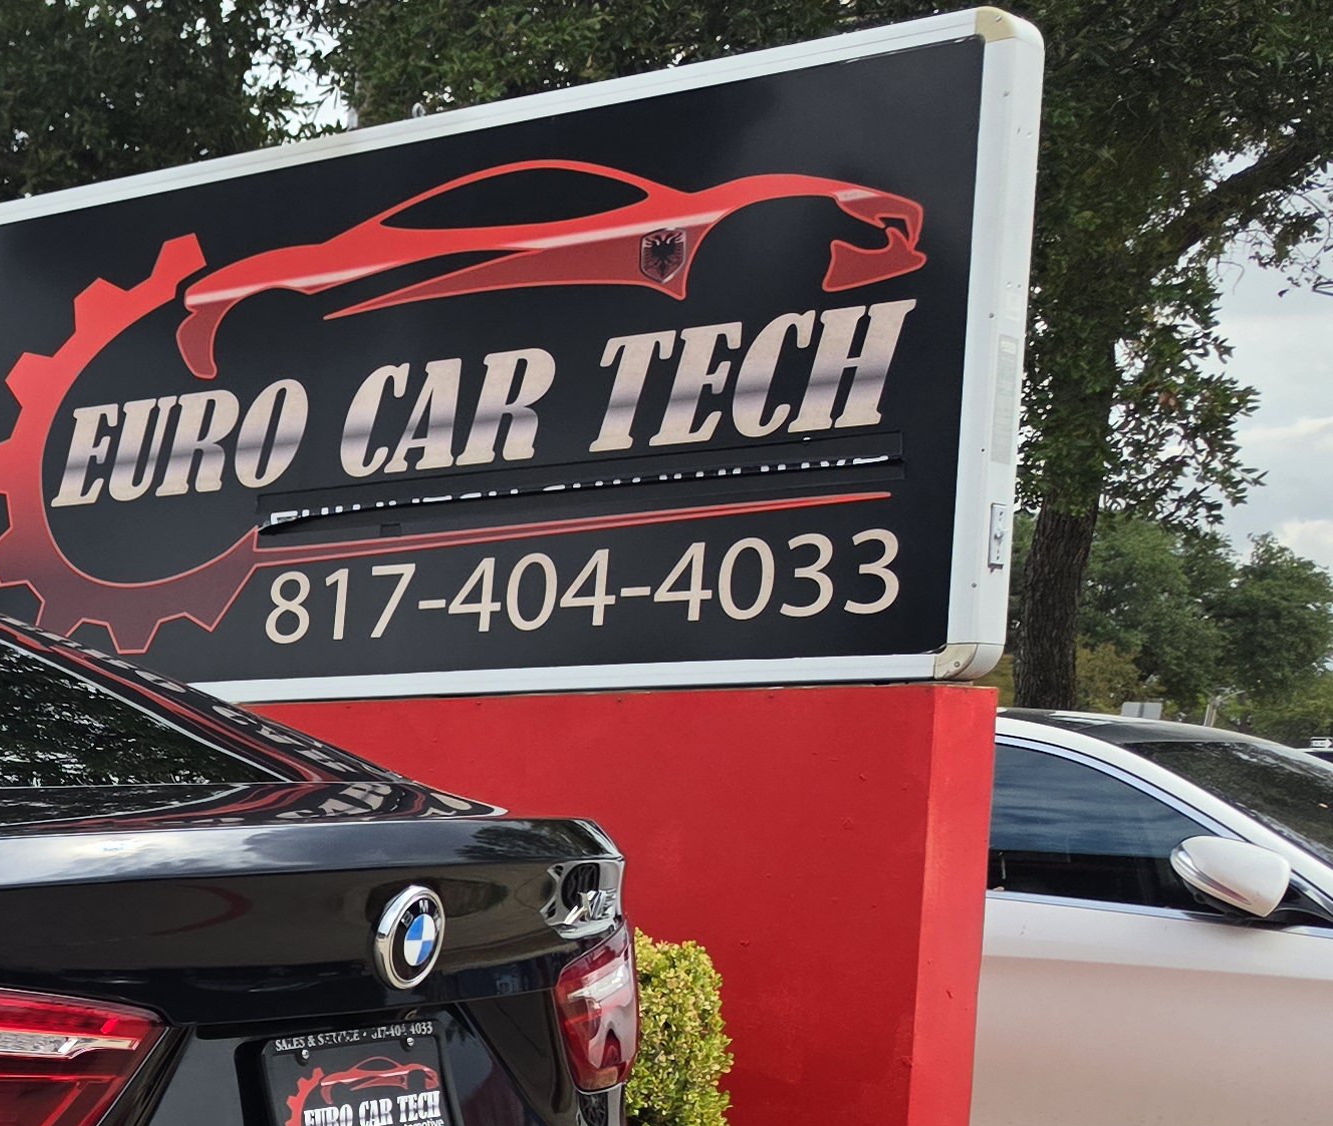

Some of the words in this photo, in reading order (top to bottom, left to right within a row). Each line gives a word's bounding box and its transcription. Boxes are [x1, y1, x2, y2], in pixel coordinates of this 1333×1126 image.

[51, 378, 309, 508] EURO
[340, 347, 557, 478] CAR
[589, 298, 917, 452] TECH
[264, 528, 901, 645] 817-404-4033
[307, 1035, 316, 1048] &
[396, 1090, 441, 1123] TECH
